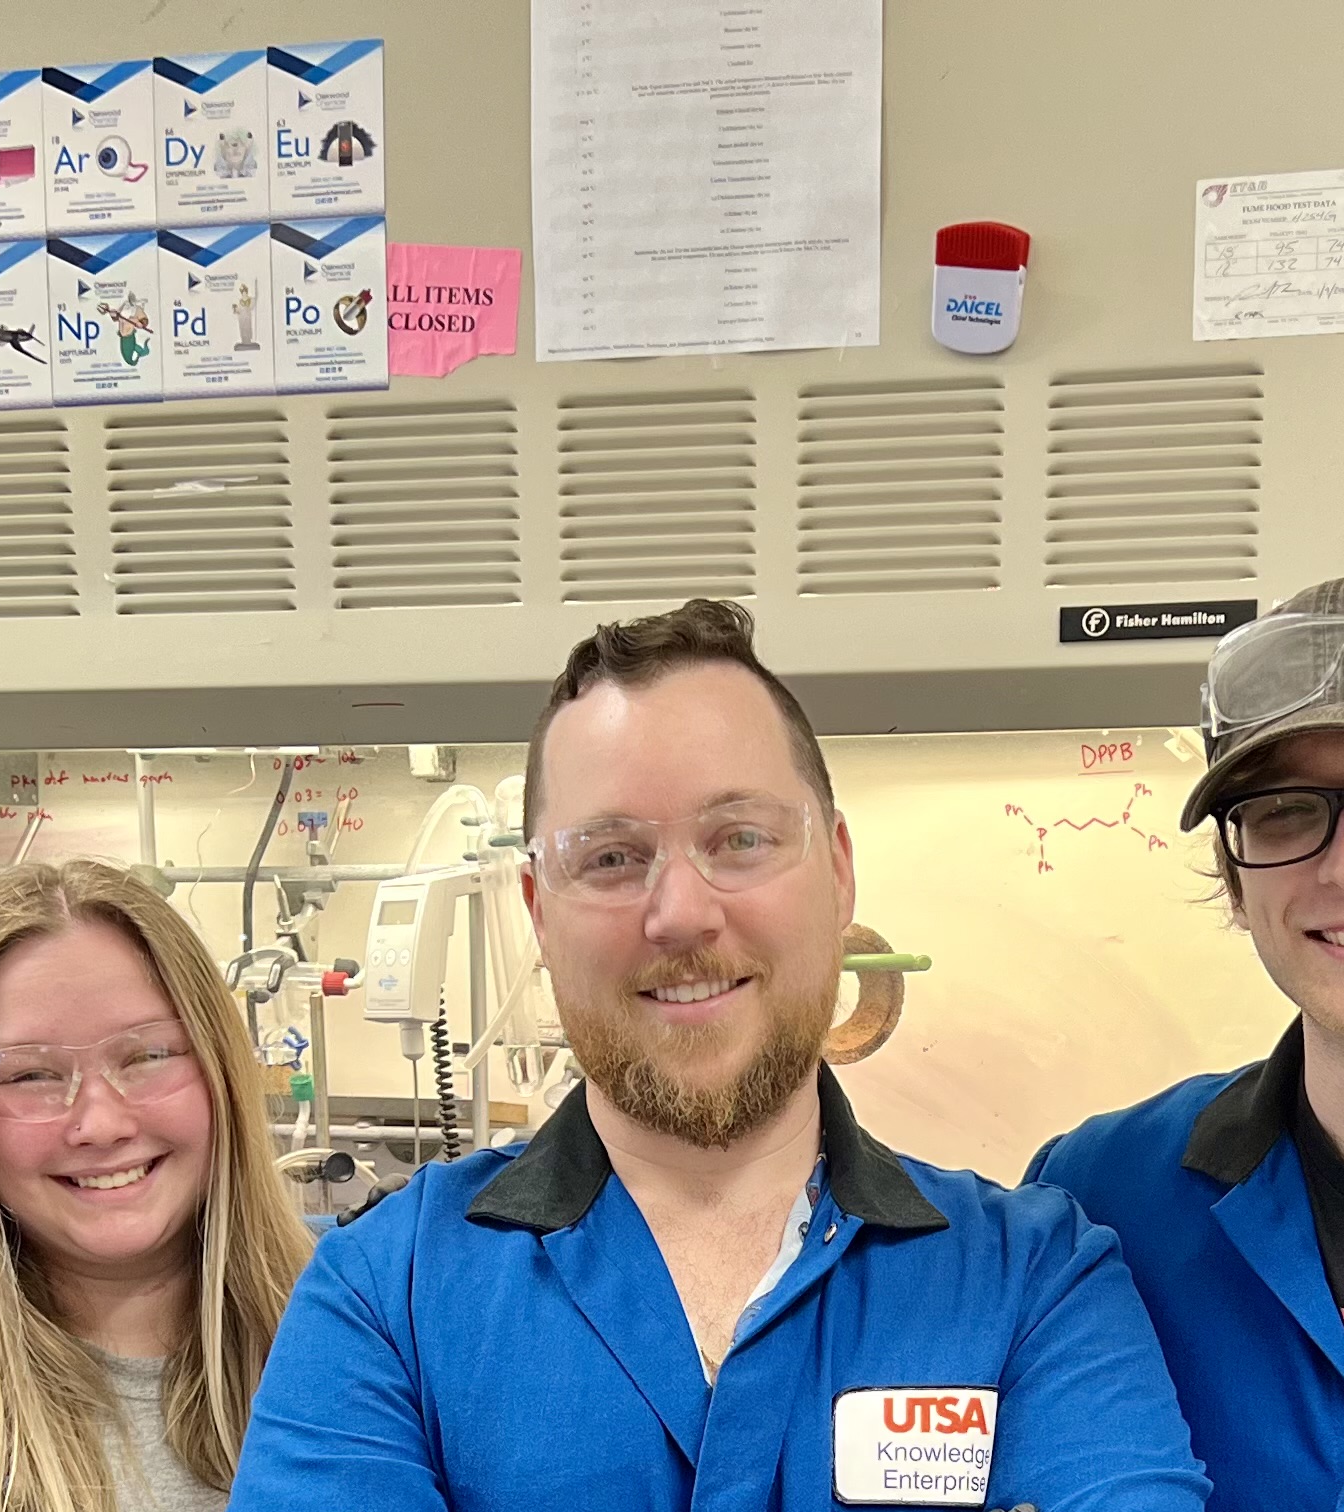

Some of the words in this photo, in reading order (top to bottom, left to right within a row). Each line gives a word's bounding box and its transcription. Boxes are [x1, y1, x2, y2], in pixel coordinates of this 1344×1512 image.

[277, 129, 310, 158] Eu
[54, 145, 90, 174] Ar
[165, 137, 205, 173] Dy
[1293, 201, 1311, 210] TEST
[1314, 200, 1336, 208] DATA
[1268, 258, 1298, 271] 132
[425, 286, 493, 306] ITEMS
[285, 297, 320, 326] Po
[946, 299, 1002, 316] DAICEL
[58, 313, 100, 348] Np
[173, 307, 206, 336] Pd
[388, 313, 476, 333] CLOSED
[1116, 614, 1158, 627] Fisher
[1161, 611, 1225, 626] Hamilton
[1081, 742, 1133, 768] DPPB
[337, 786, 358, 802] 60
[1134, 783, 1152, 797] Ph
[1005, 804, 1024, 816] Ph
[1123, 812, 1130, 824] P
[1037, 828, 1047, 841] P
[1148, 835, 1168, 851] Ph
[1038, 861, 1054, 874] Ph
[884, 1397, 988, 1435] UTSA
[878, 1442, 989, 1469] Knowledge
[884, 1469, 985, 1495] Enterprise
